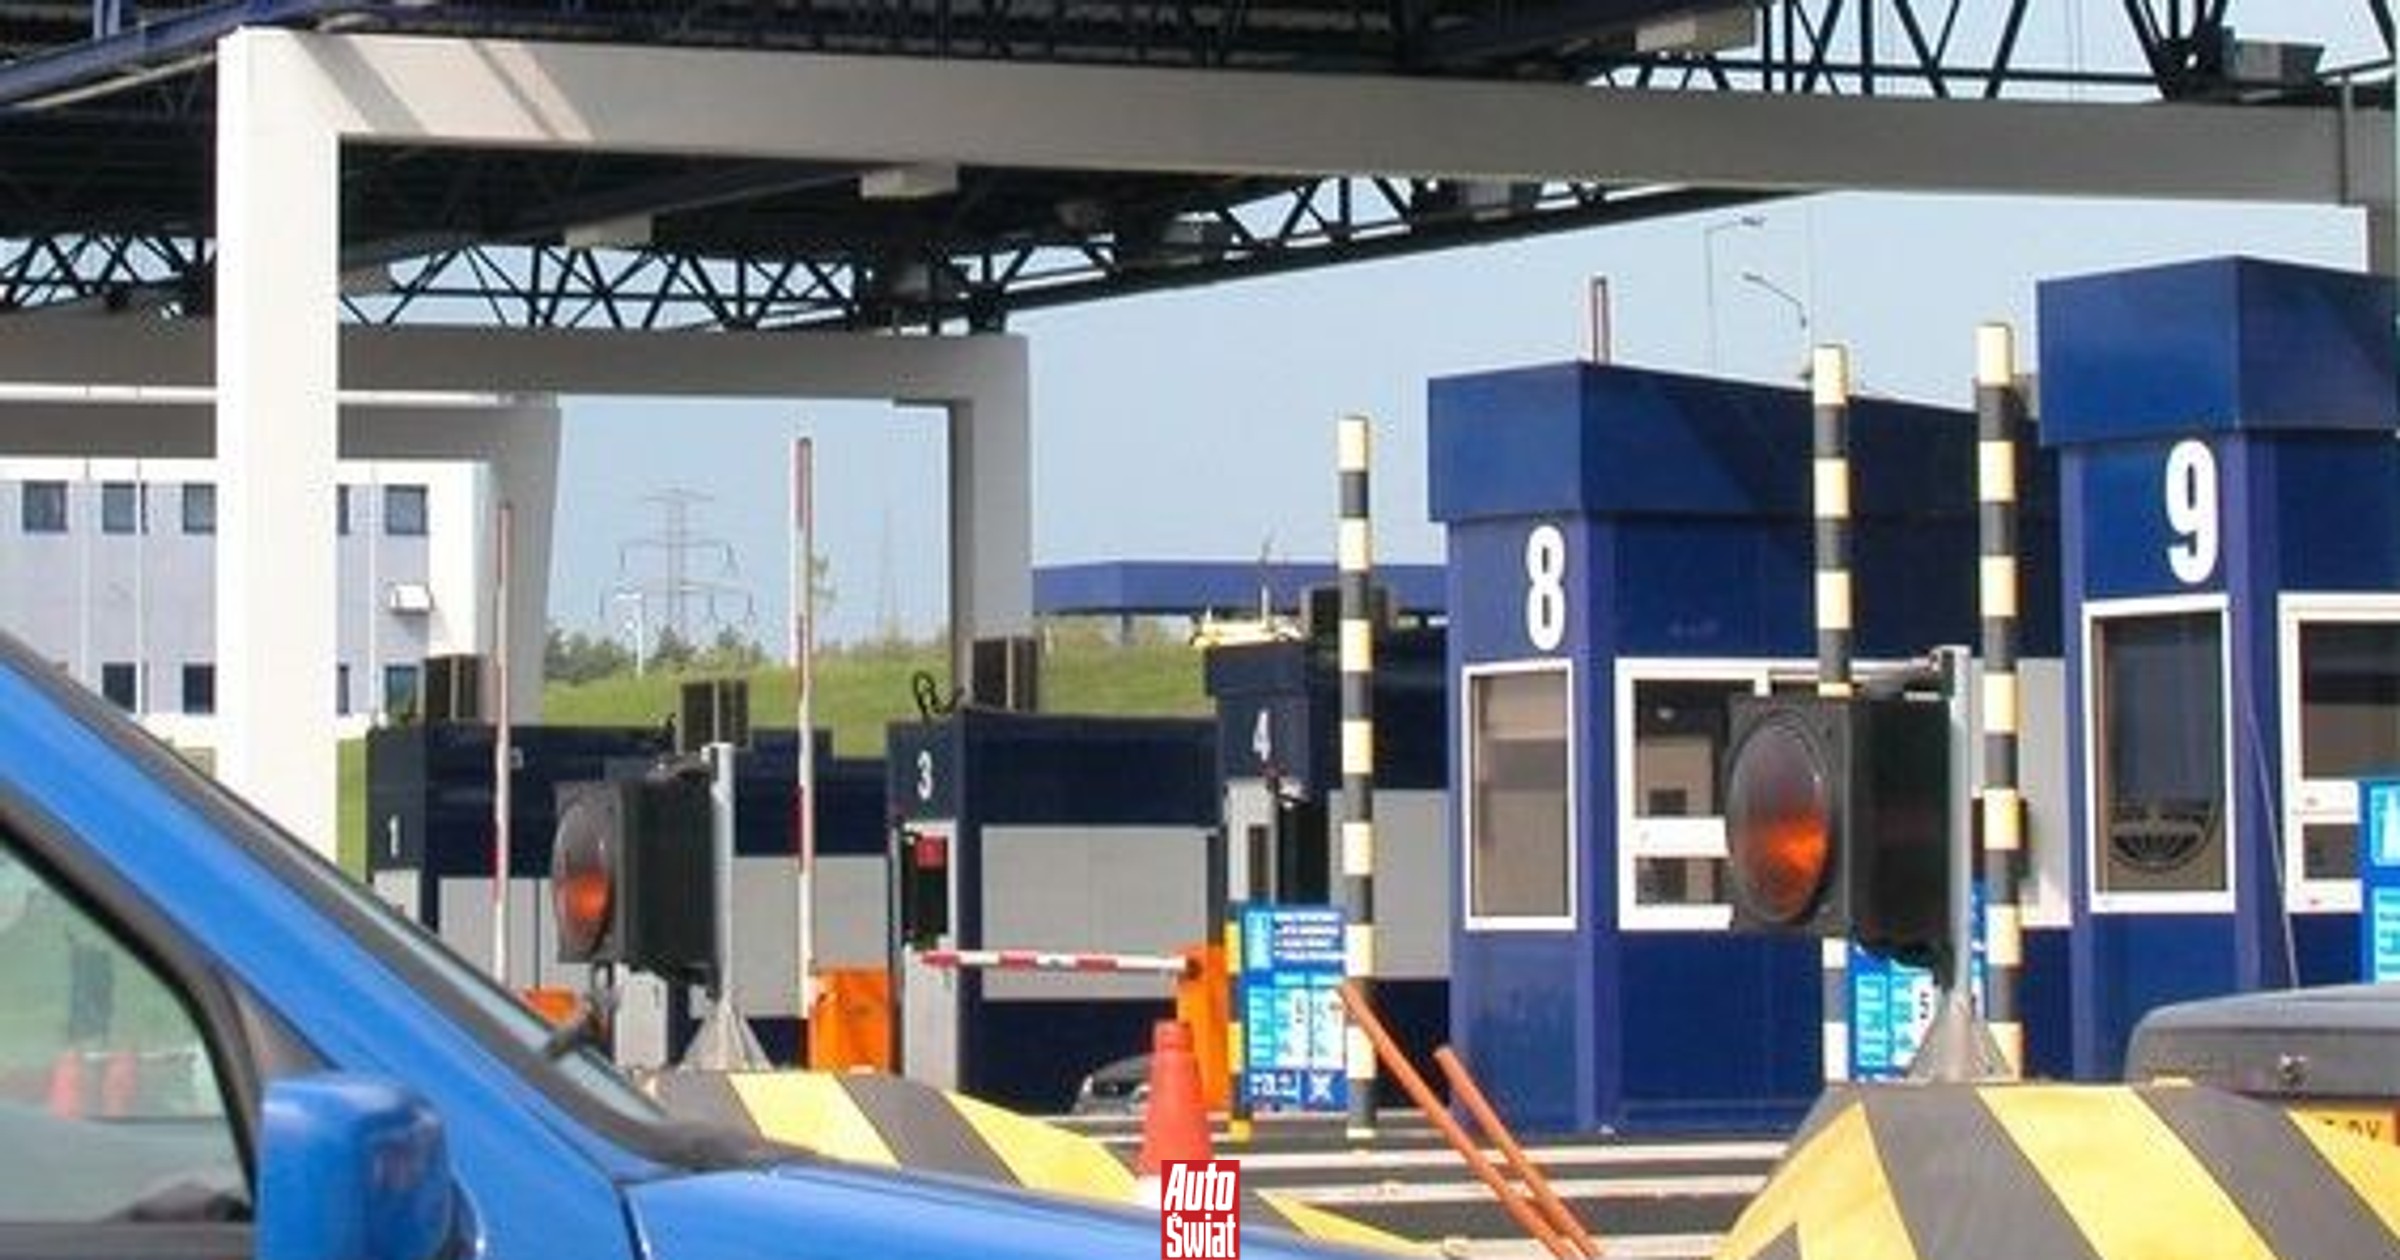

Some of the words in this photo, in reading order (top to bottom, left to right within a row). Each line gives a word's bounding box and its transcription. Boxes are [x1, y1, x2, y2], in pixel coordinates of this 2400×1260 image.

[2166, 438, 2218, 583] 9
[1527, 524, 1565, 650] 8
[1252, 709, 1271, 761] 4
[917, 750, 933, 800] 3
[388, 814, 400, 858] 1
